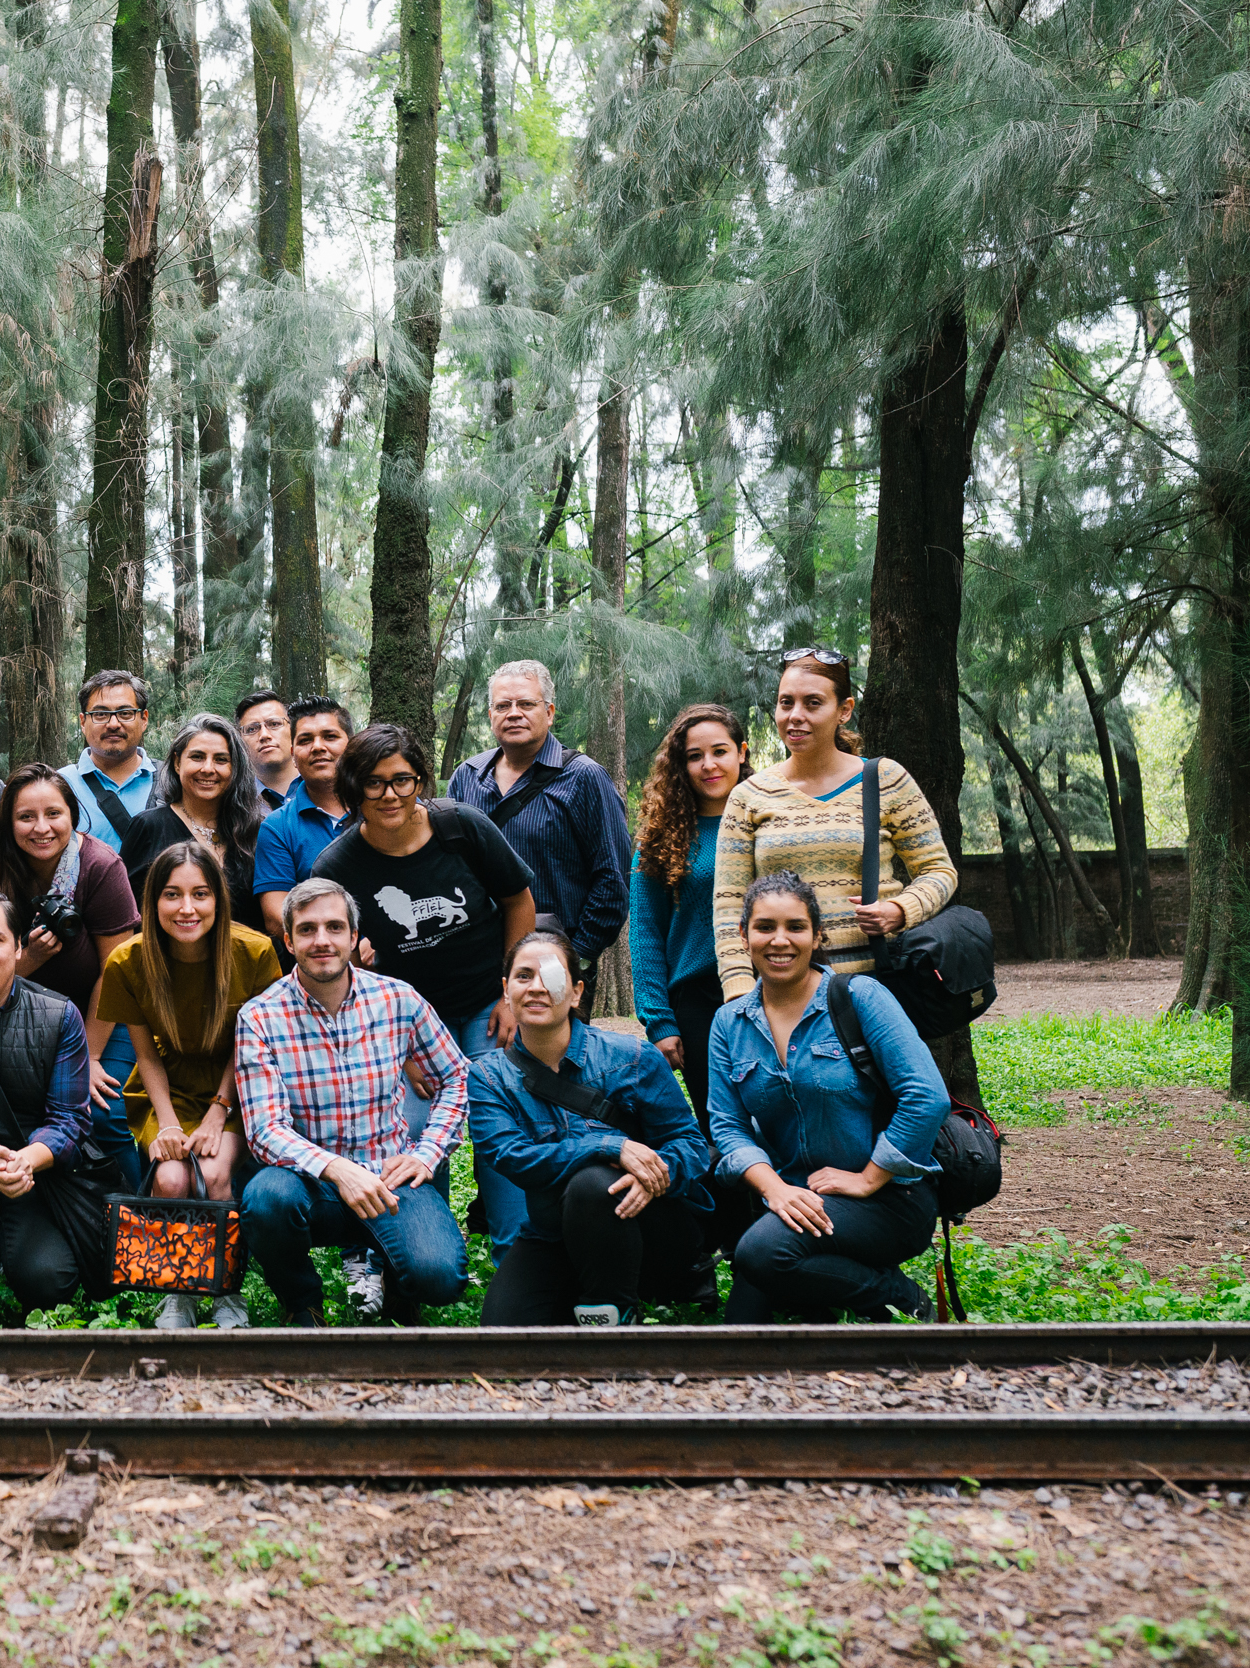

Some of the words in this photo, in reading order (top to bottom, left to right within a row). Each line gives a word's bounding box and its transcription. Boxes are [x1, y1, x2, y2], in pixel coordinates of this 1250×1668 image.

[411, 900, 446, 916] FFIEL
[398, 940, 424, 949] FESTIVAL
[400, 936, 444, 954] INTERNACIONAL
